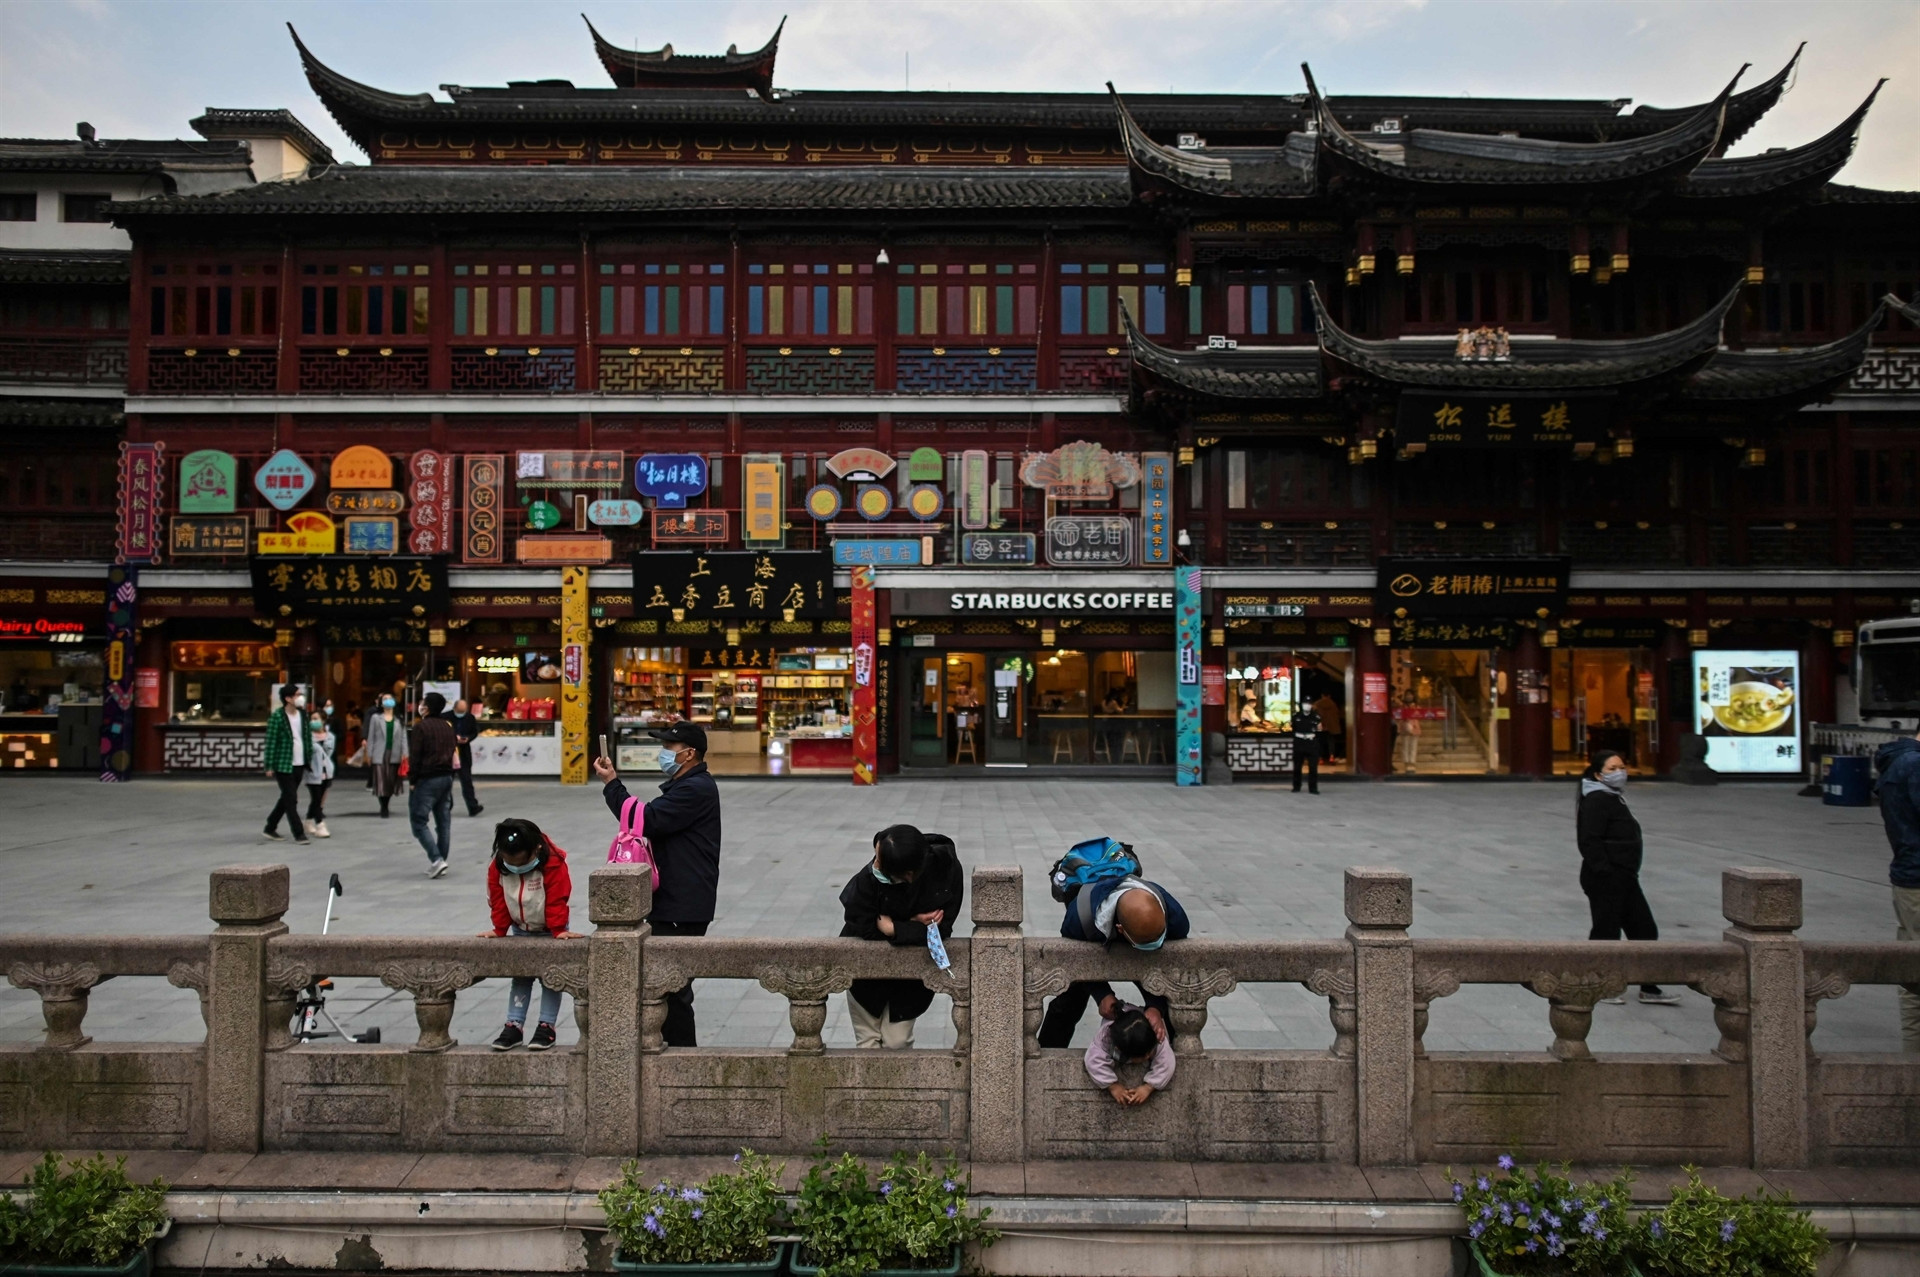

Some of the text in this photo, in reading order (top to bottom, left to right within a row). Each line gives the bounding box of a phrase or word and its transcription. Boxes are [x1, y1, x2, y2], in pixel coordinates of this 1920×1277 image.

[1429, 433, 1573, 442] SONG YUN TOWER
[131, 458, 149, 548] 春风松月楼
[475, 465, 492, 552] 你好元宵
[1083, 522, 1121, 545] 老庙
[839, 545, 912, 562] 老城隍庙
[690, 556, 777, 579] 上海
[646, 582, 806, 610] 五香豆商店
[951, 593, 1174, 610] STARBUCKS COFFEE
[0, 618, 84, 634] airy Queen
